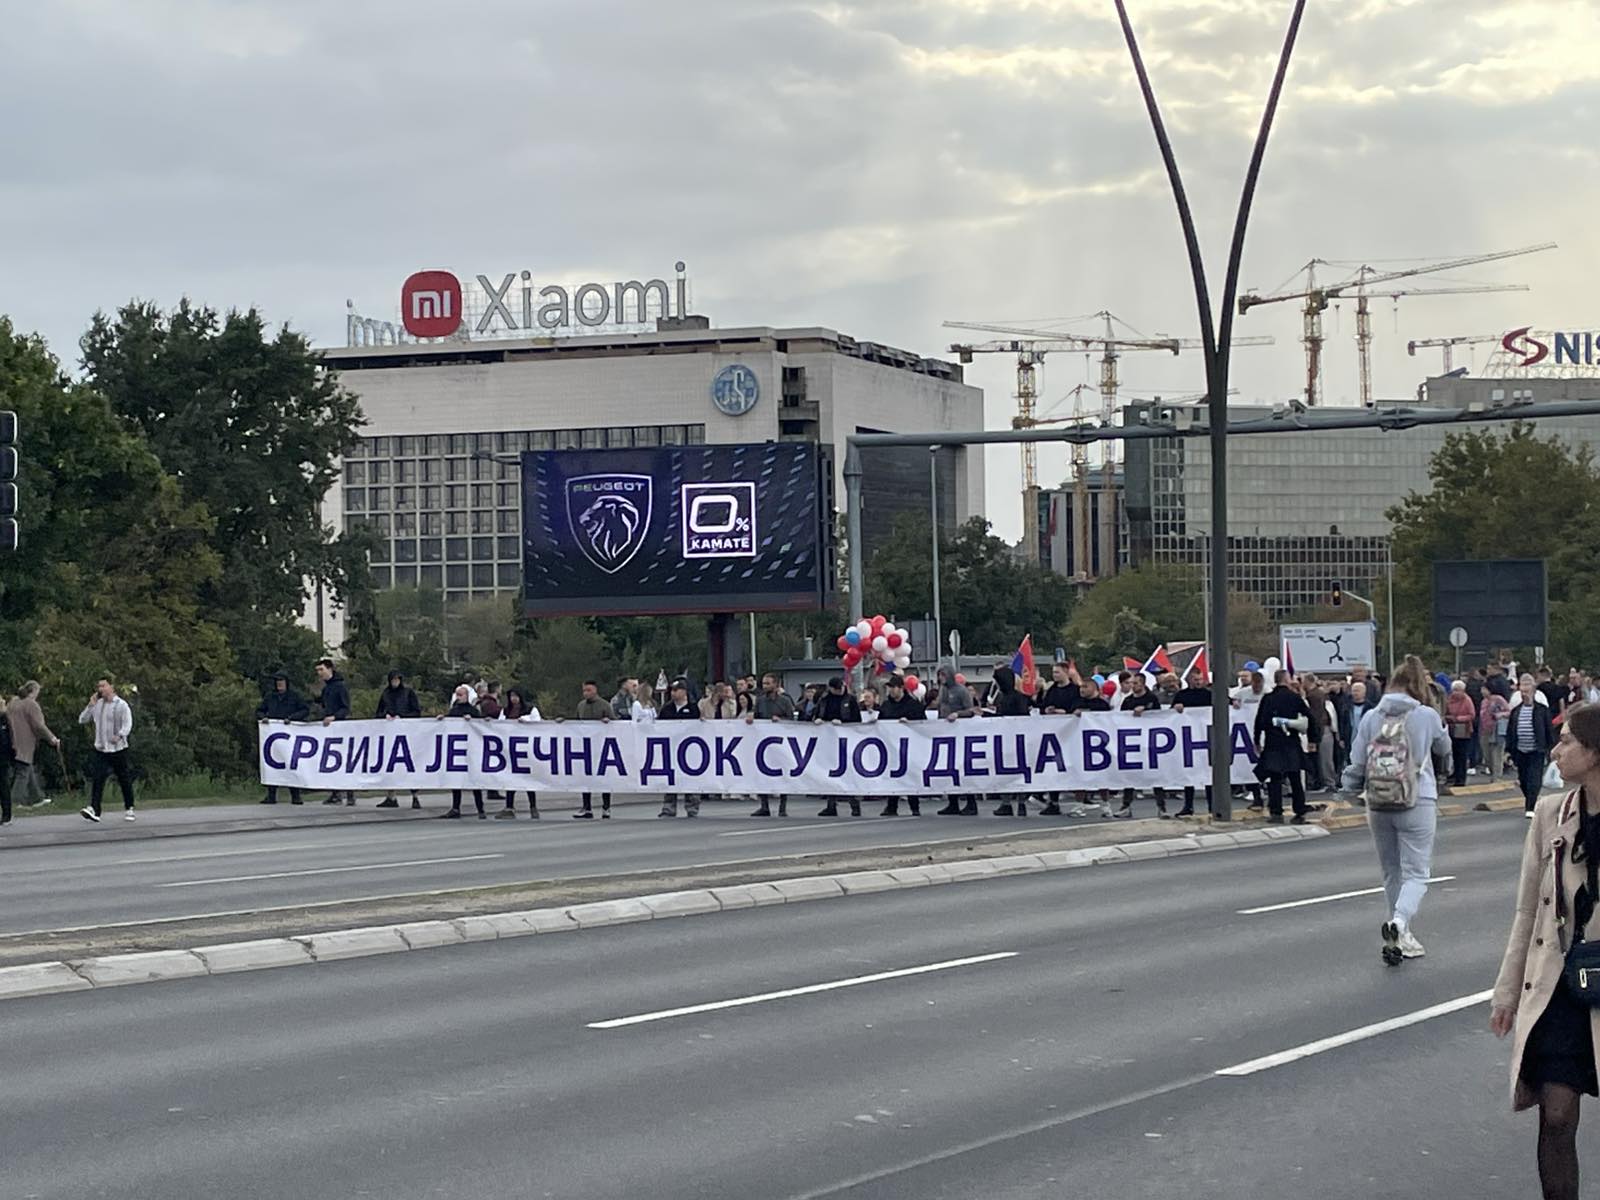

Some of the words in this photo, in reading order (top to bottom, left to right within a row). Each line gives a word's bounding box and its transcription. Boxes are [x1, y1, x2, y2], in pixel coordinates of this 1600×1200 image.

[475, 261, 687, 334] Xiaomi
[1554, 331, 1600, 366] NI
[572, 481, 646, 493] PEUGEOT
[689, 494, 750, 534] 0%
[690, 537, 751, 549] KAMATE
[262, 731, 416, 774] СРБИЈА
[425, 734, 469, 773] ЈЕ
[481, 734, 628, 777] ВЕЧНА
[639, 735, 744, 786] ДОК
[755, 736, 818, 778] СУ
[828, 737, 909, 779] ЈОЈ
[922, 733, 1067, 788] ДЕЦА
[1081, 722, 1260, 772] ВЕРНА
